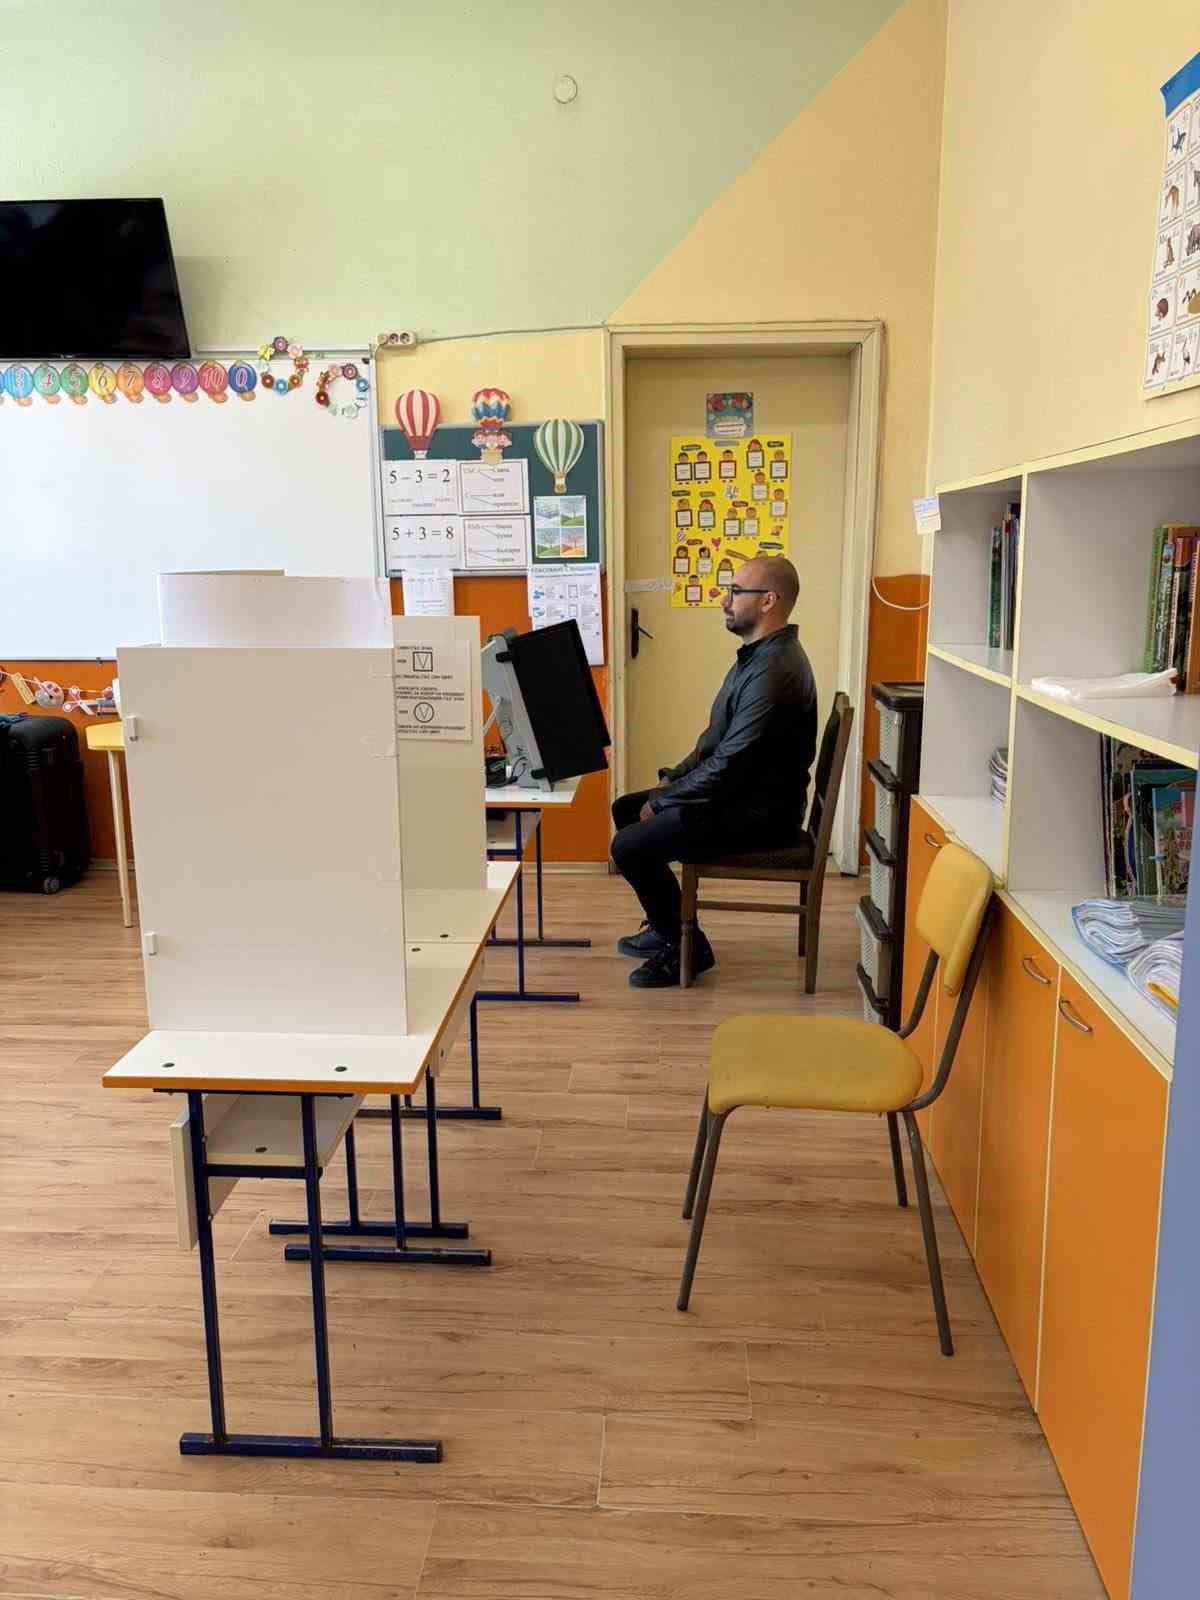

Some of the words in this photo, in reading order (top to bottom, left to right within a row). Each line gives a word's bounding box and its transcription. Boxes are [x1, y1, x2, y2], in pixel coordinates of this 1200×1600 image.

[41, 368, 53, 387] 4
[97, 369, 108, 389] 6
[127, 369, 137, 387] 7
[151, 369, 164, 388] 8
[178, 369, 191, 388] 9
[203, 367, 224, 388] 10
[389, 470, 397, 484] 5
[415, 469, 423, 484] 3
[441, 468, 450, 483] 2
[392, 527, 400, 541] 5
[404, 528, 414, 538] +
[418, 526, 426, 541] 3
[446, 526, 454, 540] 8
[417, 655, 429, 669] V
[418, 706, 429, 720] V
